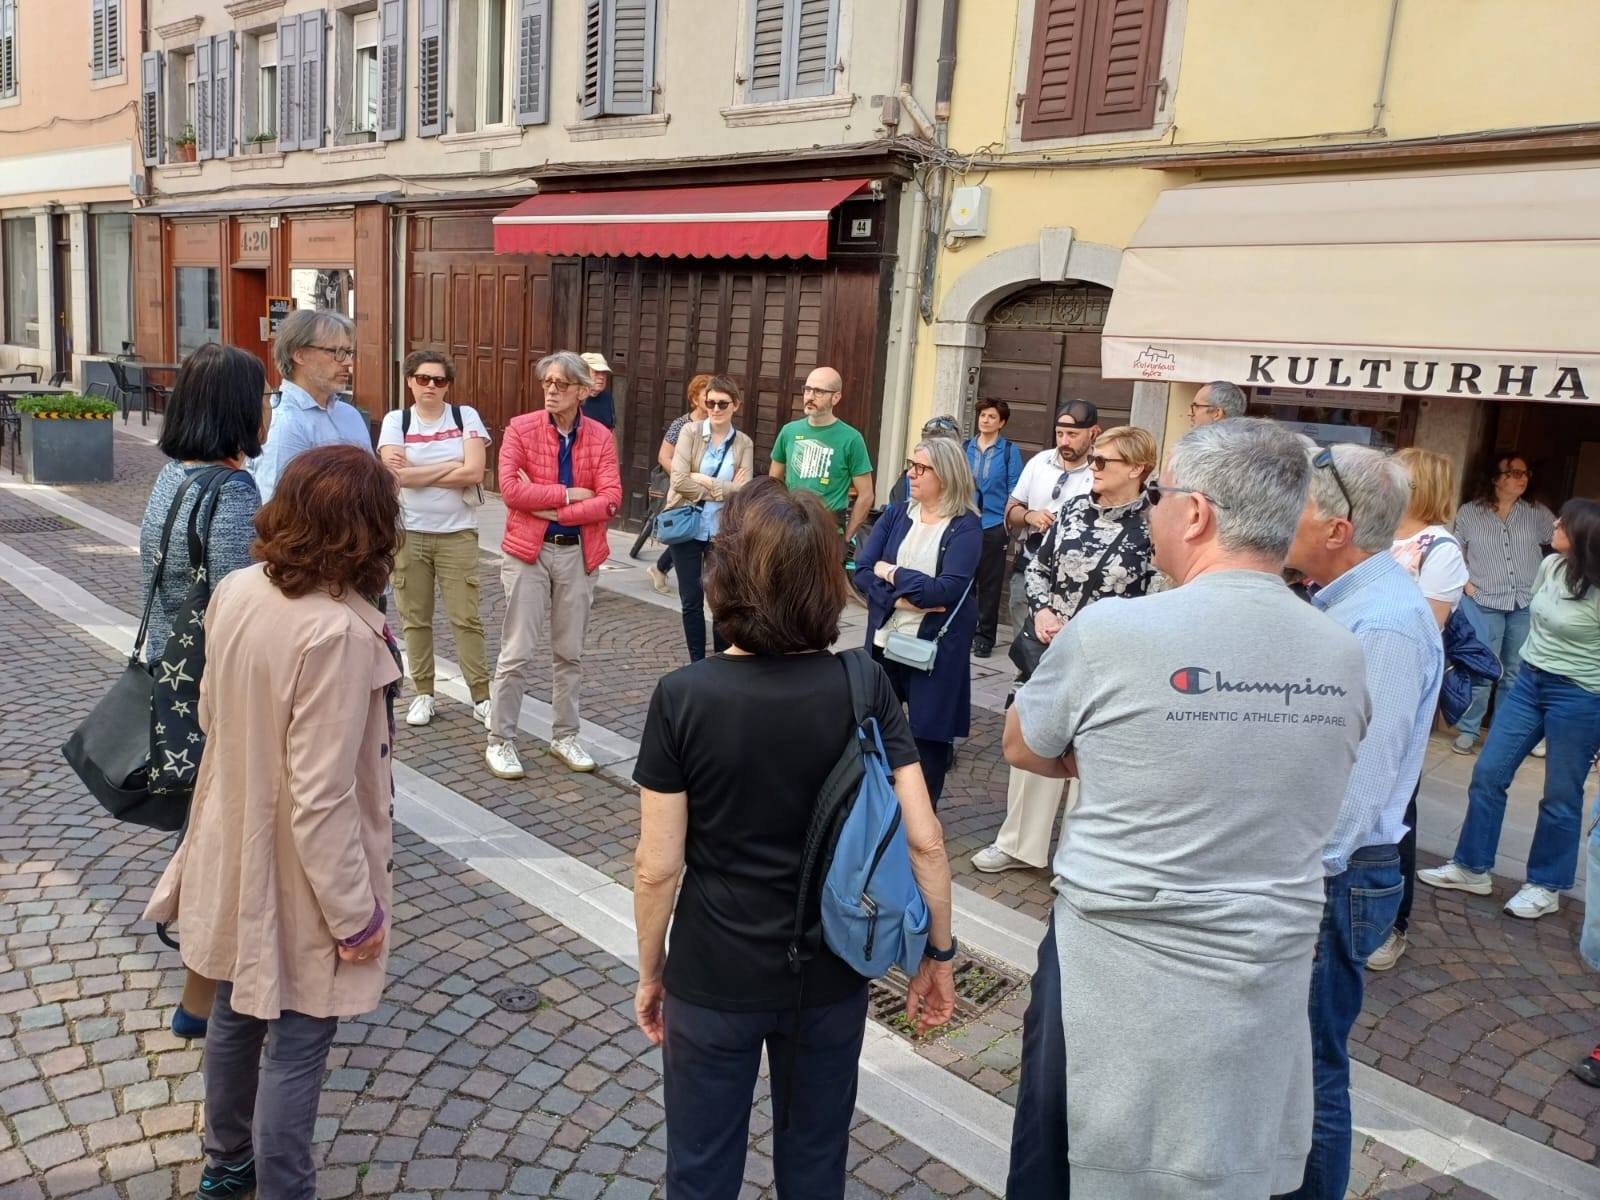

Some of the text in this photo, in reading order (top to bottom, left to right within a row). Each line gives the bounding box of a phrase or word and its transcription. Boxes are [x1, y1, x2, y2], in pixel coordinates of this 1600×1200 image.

[856, 221, 866, 233] 44
[240, 231, 269, 251] 4:20
[1246, 354, 1590, 400] KULTURHA
[1169, 666, 1348, 706] Champion
[1165, 711, 1347, 728] AUTHENTIC ATHLETIC APPAREL
